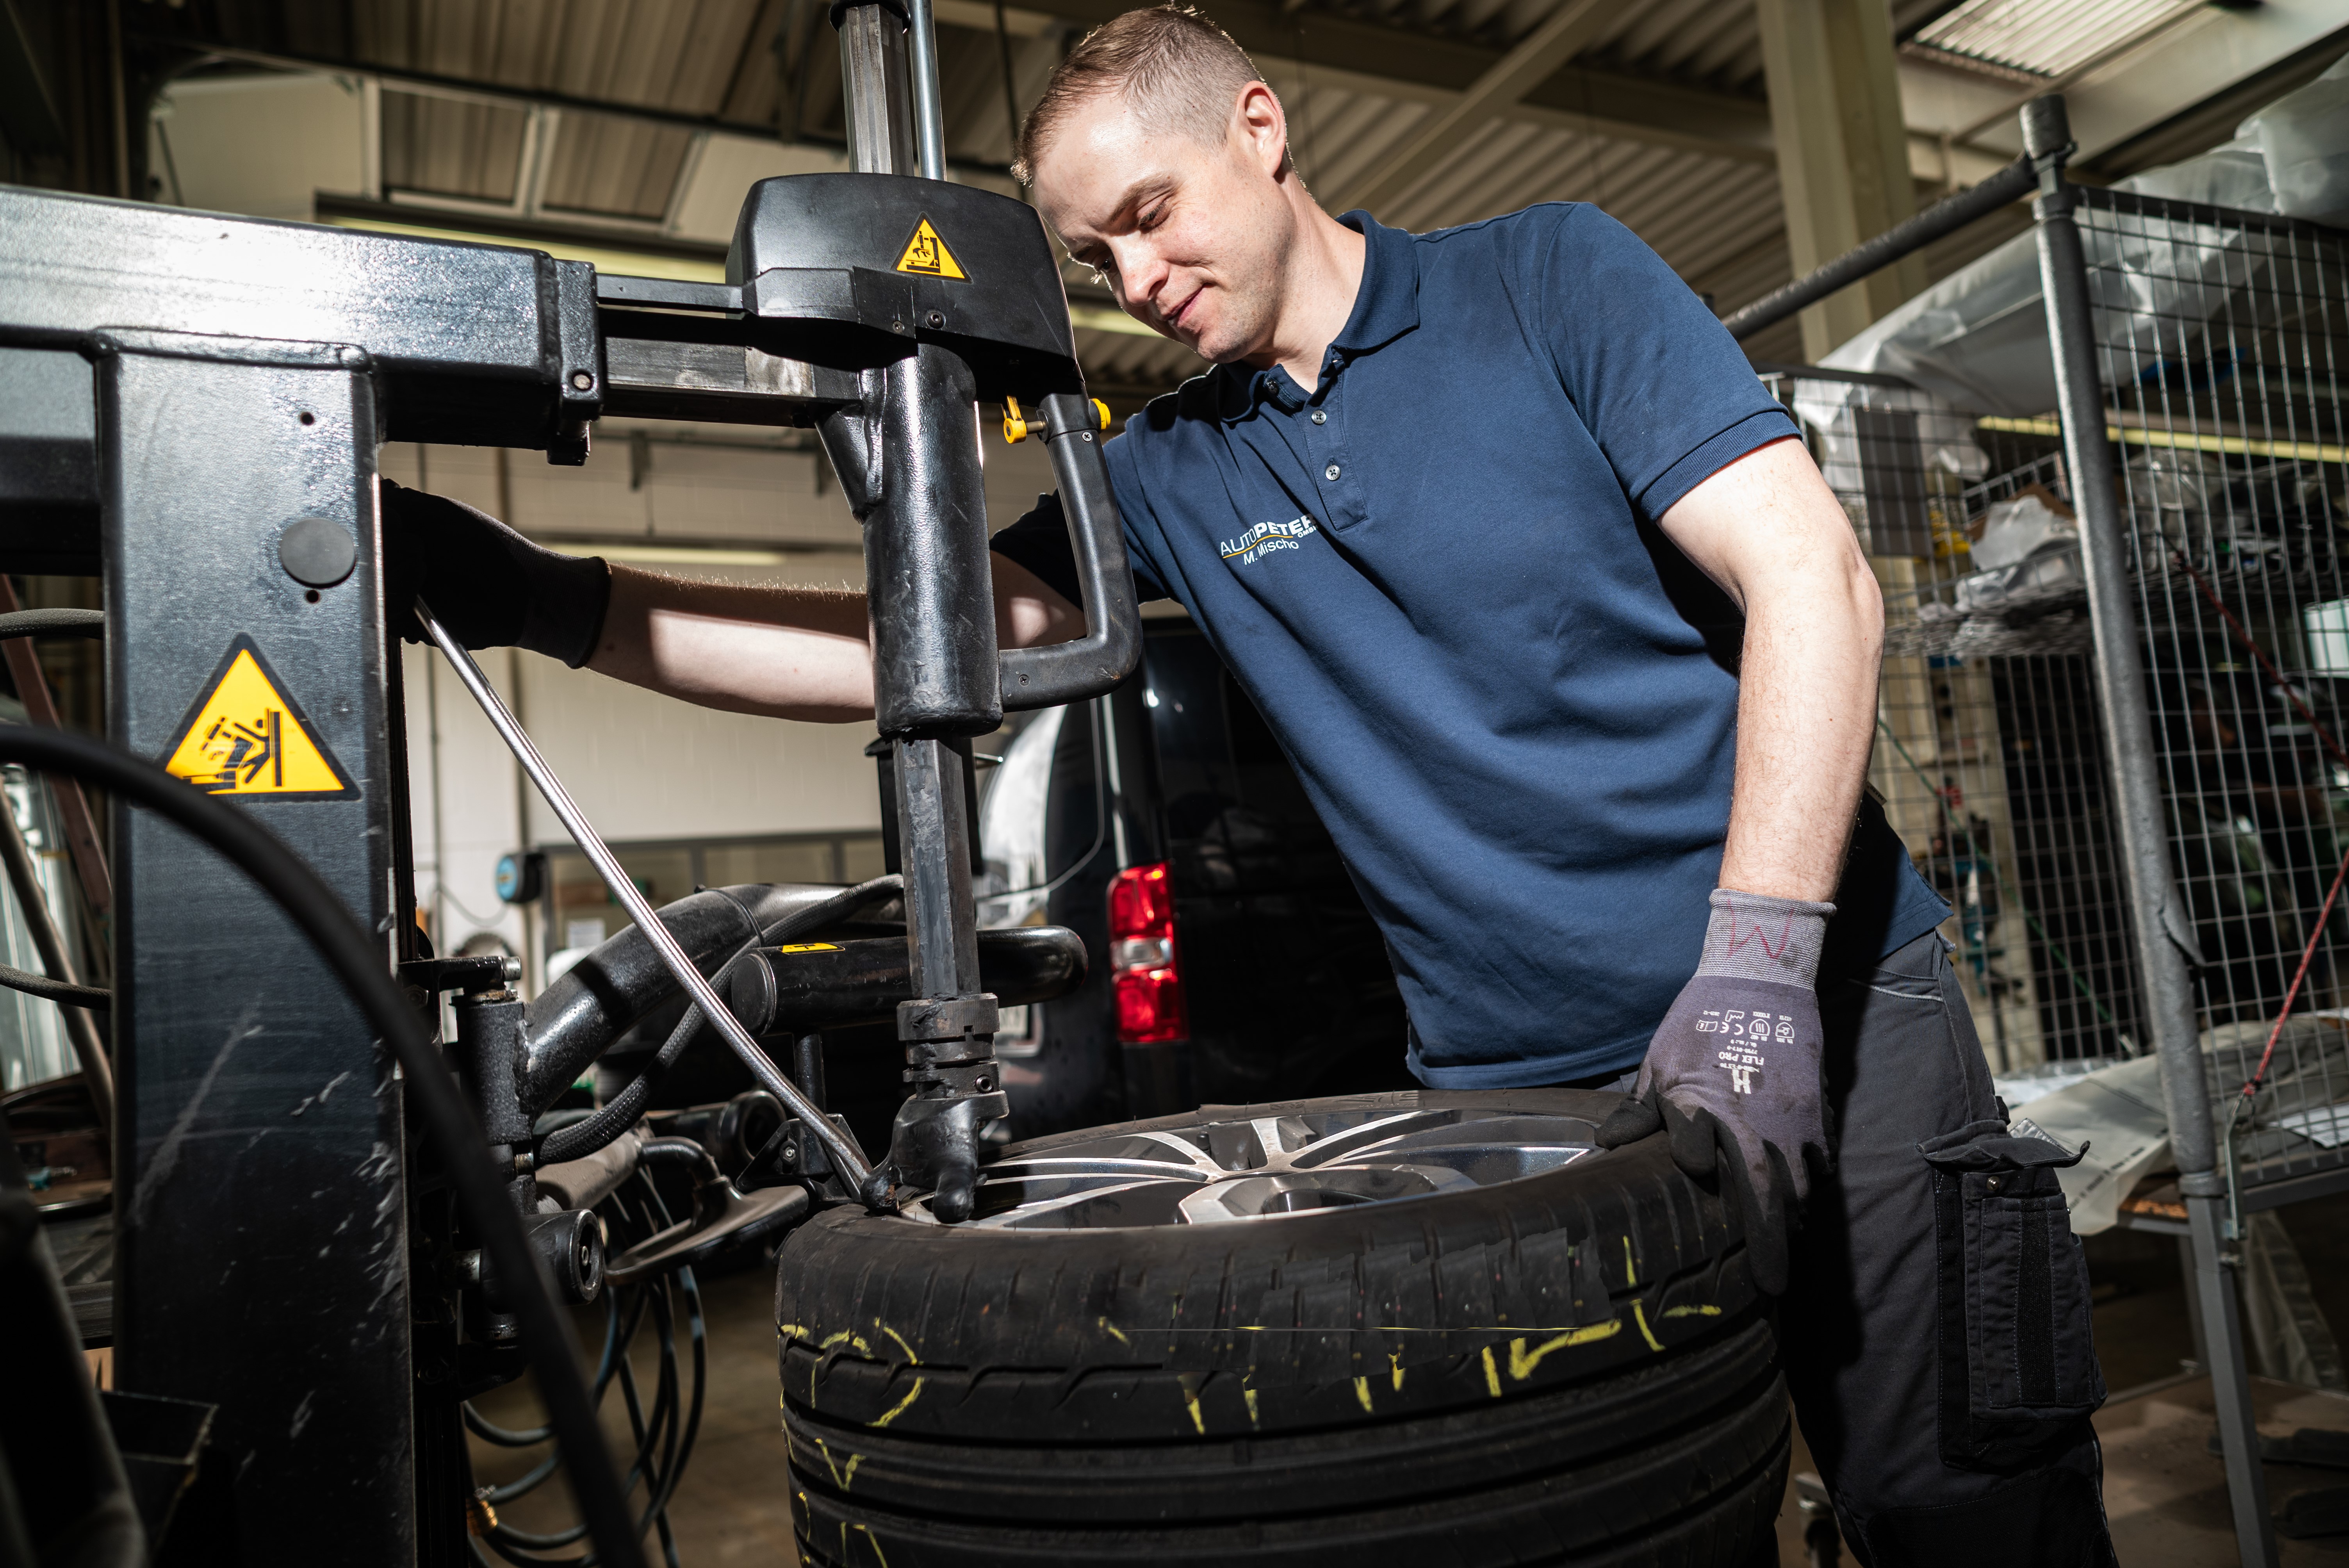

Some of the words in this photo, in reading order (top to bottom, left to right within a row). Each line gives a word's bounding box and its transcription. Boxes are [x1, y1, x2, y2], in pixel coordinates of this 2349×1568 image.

[1243, 551, 1258, 565] M.
[1257, 538, 1299, 558] Mischo
[1718, 1051, 1739, 1062] PRO
[1742, 1055, 1764, 1066] FLEX
